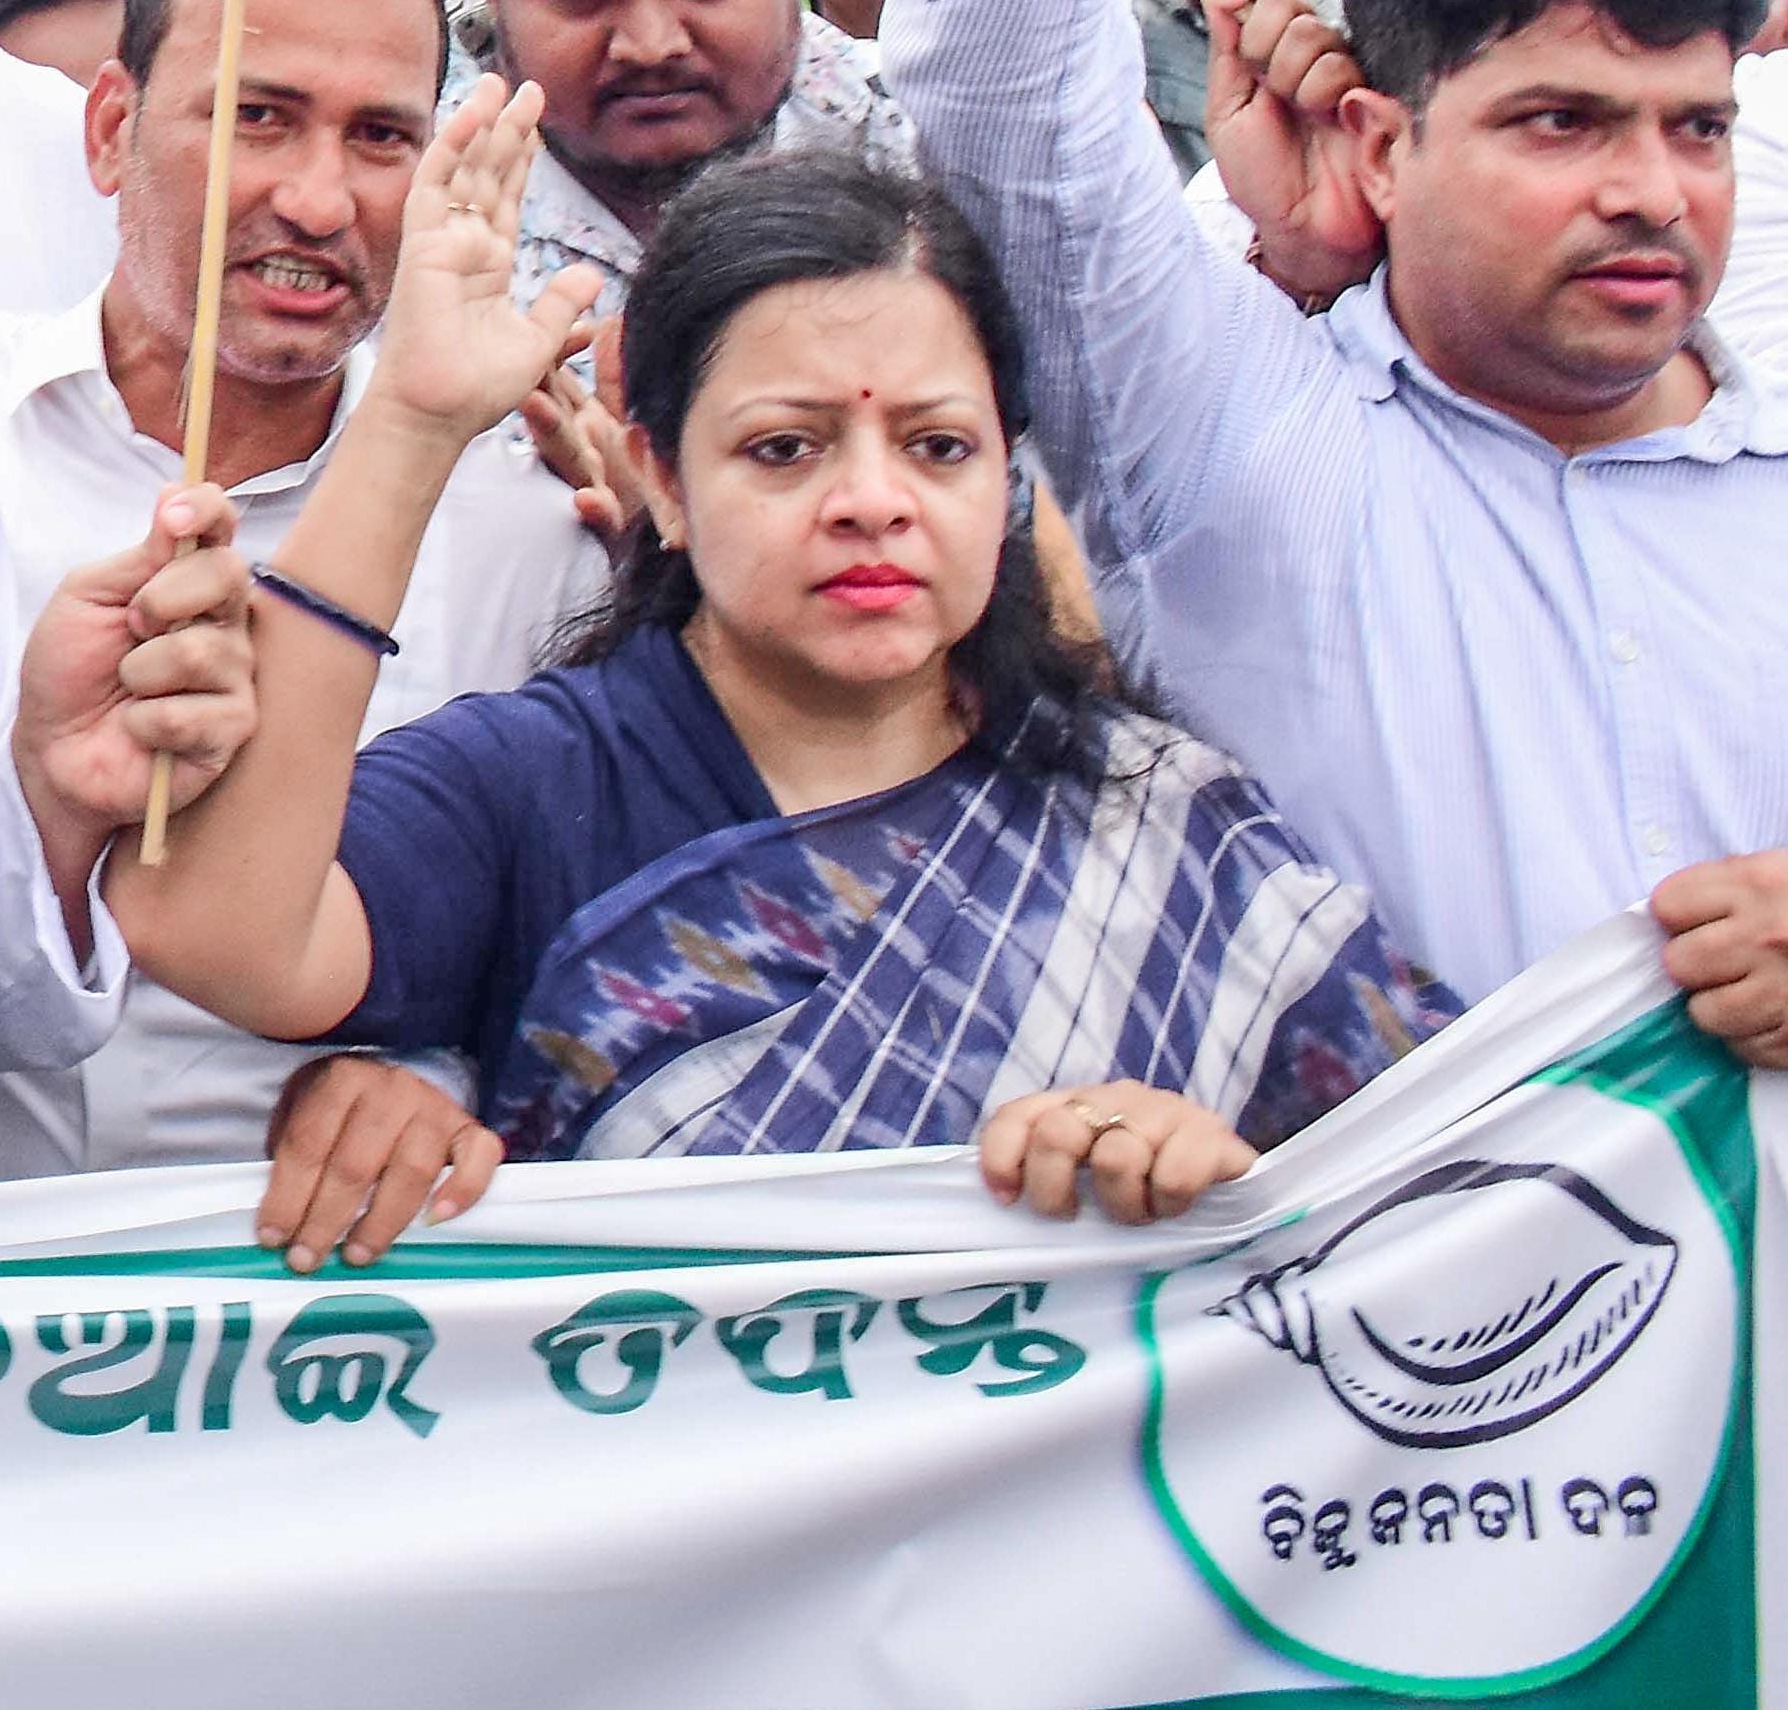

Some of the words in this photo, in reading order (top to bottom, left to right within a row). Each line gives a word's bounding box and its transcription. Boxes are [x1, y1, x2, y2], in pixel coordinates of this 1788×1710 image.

[1262, 1484, 1355, 1569] ବିଜୁ
[1370, 1477, 1537, 1541] ଜନତା
[1564, 1474, 1657, 1536] ଦଳ
